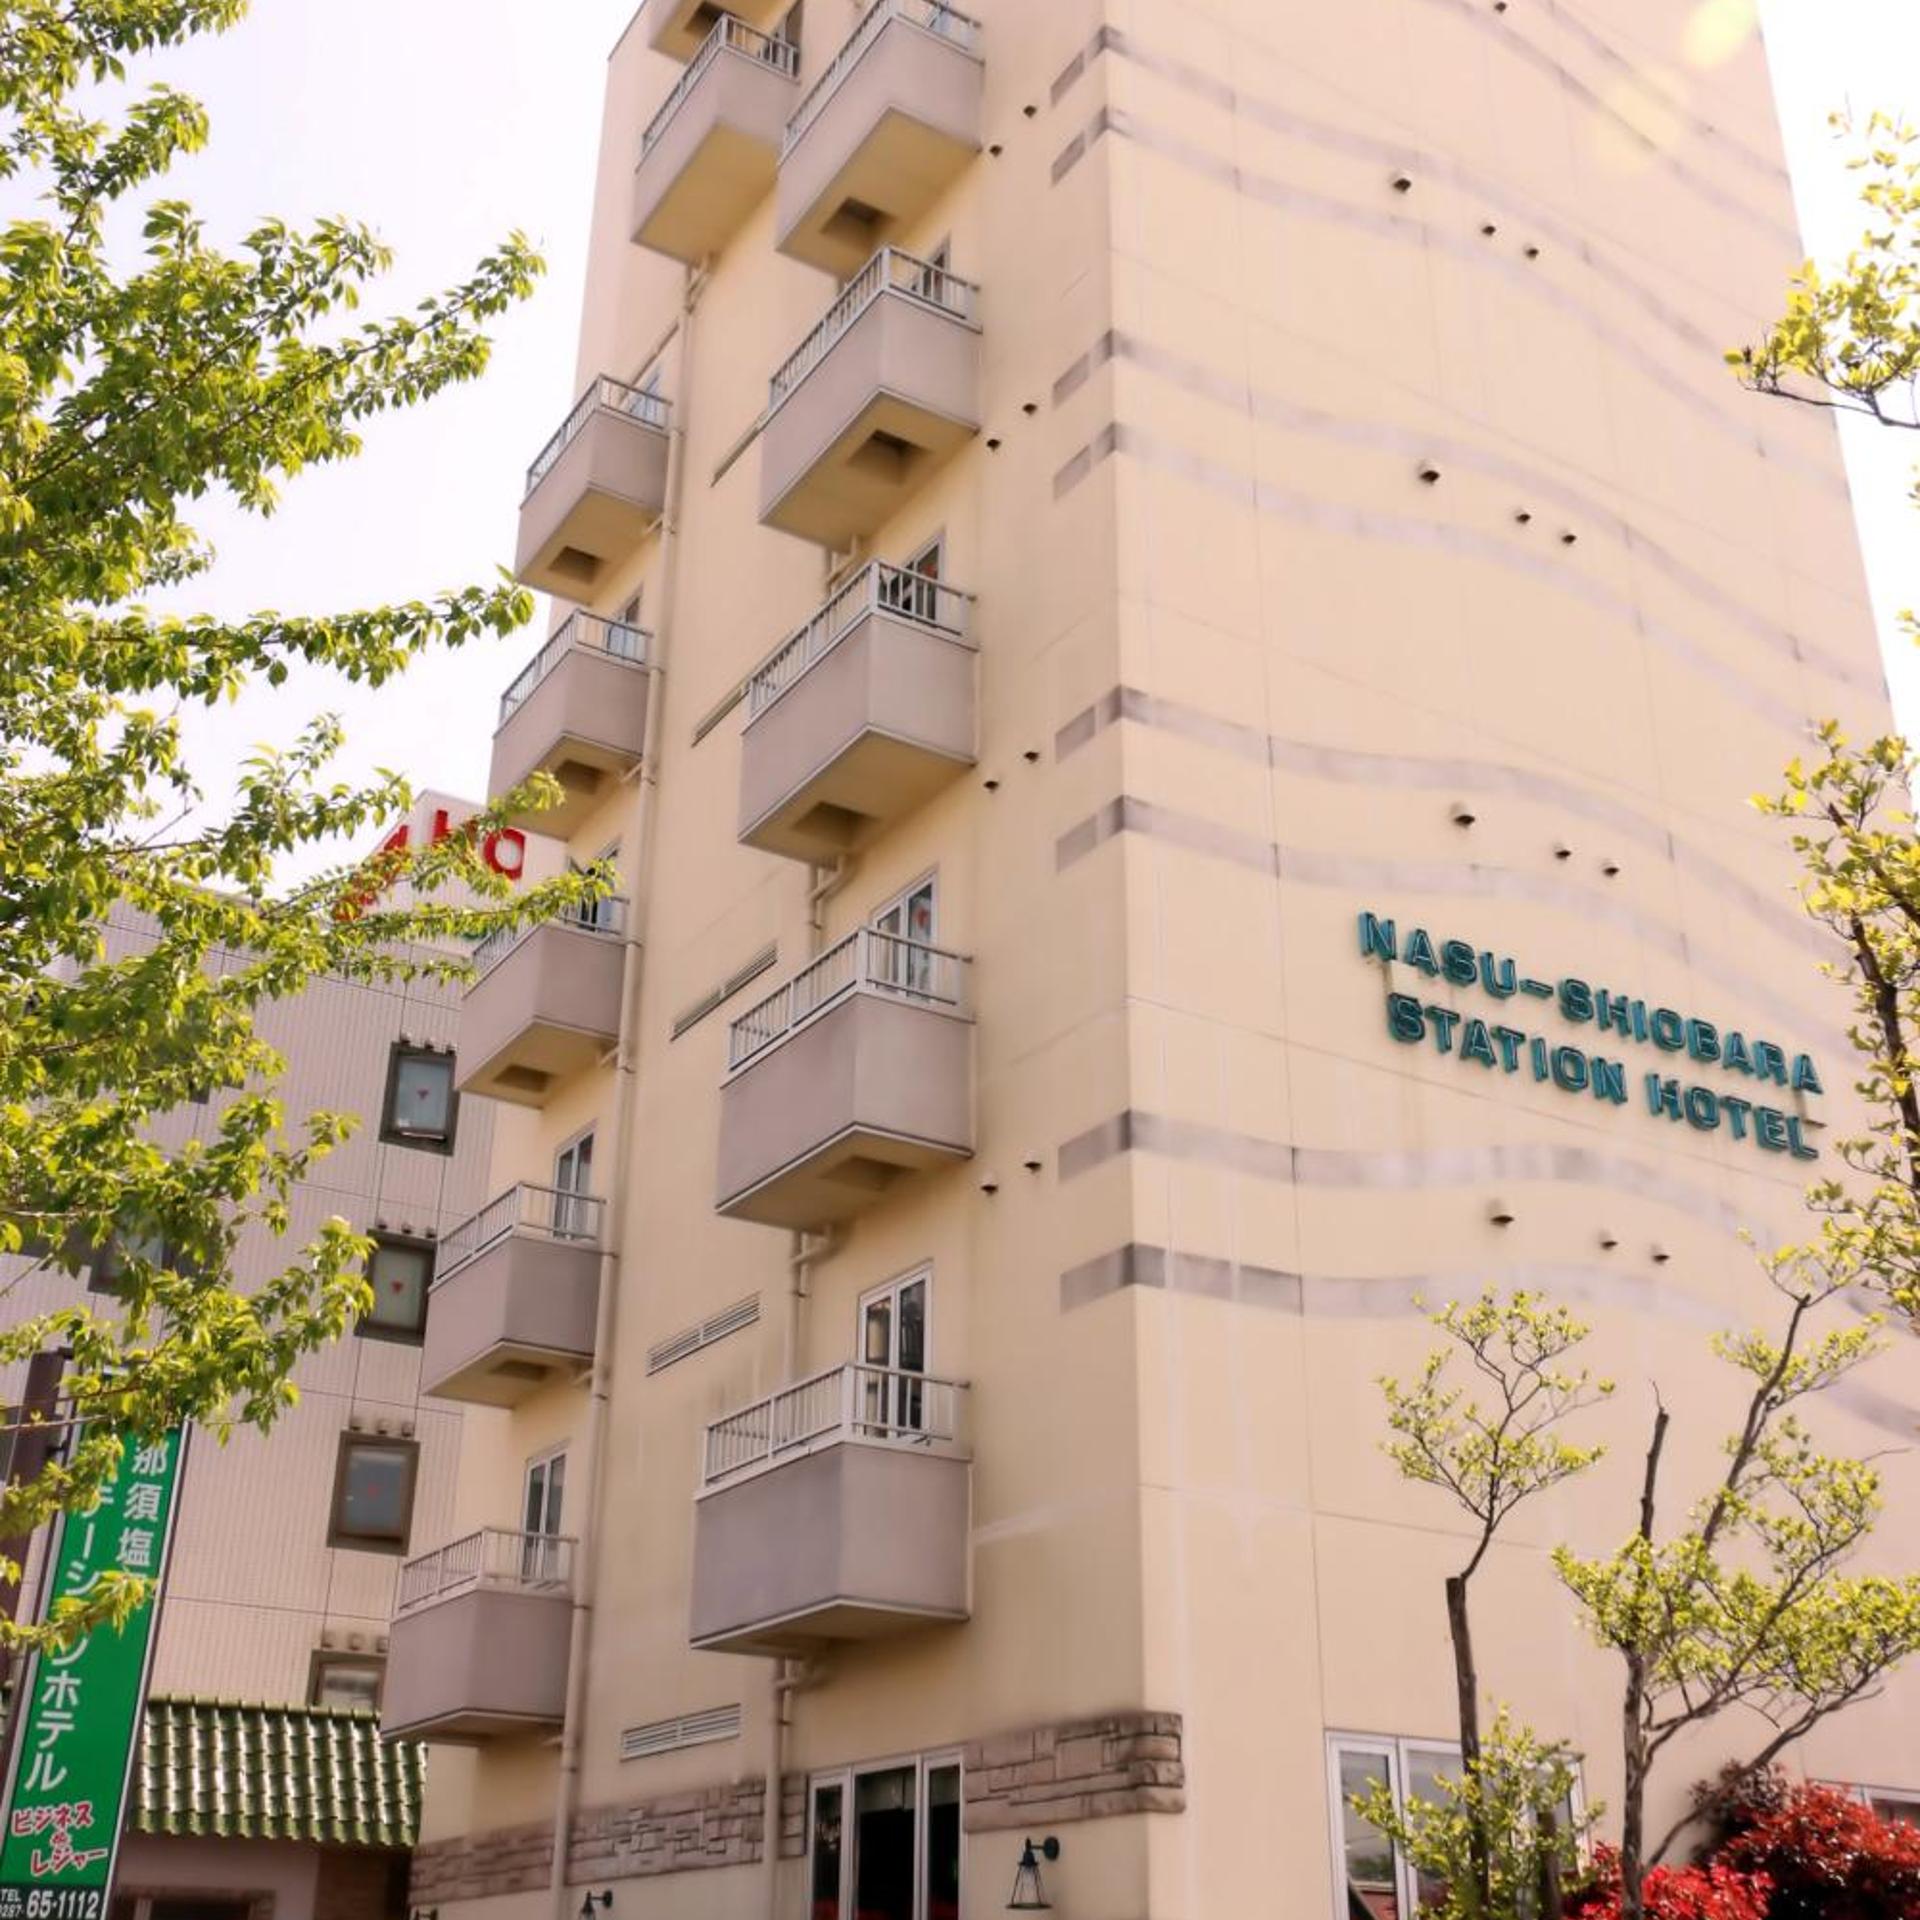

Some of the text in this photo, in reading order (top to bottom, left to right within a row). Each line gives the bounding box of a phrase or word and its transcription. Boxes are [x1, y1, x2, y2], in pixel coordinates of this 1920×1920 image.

[1358, 911, 1824, 1095] NASU-SHIOBARA
[1387, 992, 1818, 1160] STATION HOTEL
[115, 1437, 169, 1579] 那須塩
[11, 1800, 94, 1837] ビジネス
[30, 1848, 108, 1877] レジャー
[0, 1888, 21, 1902] TEL
